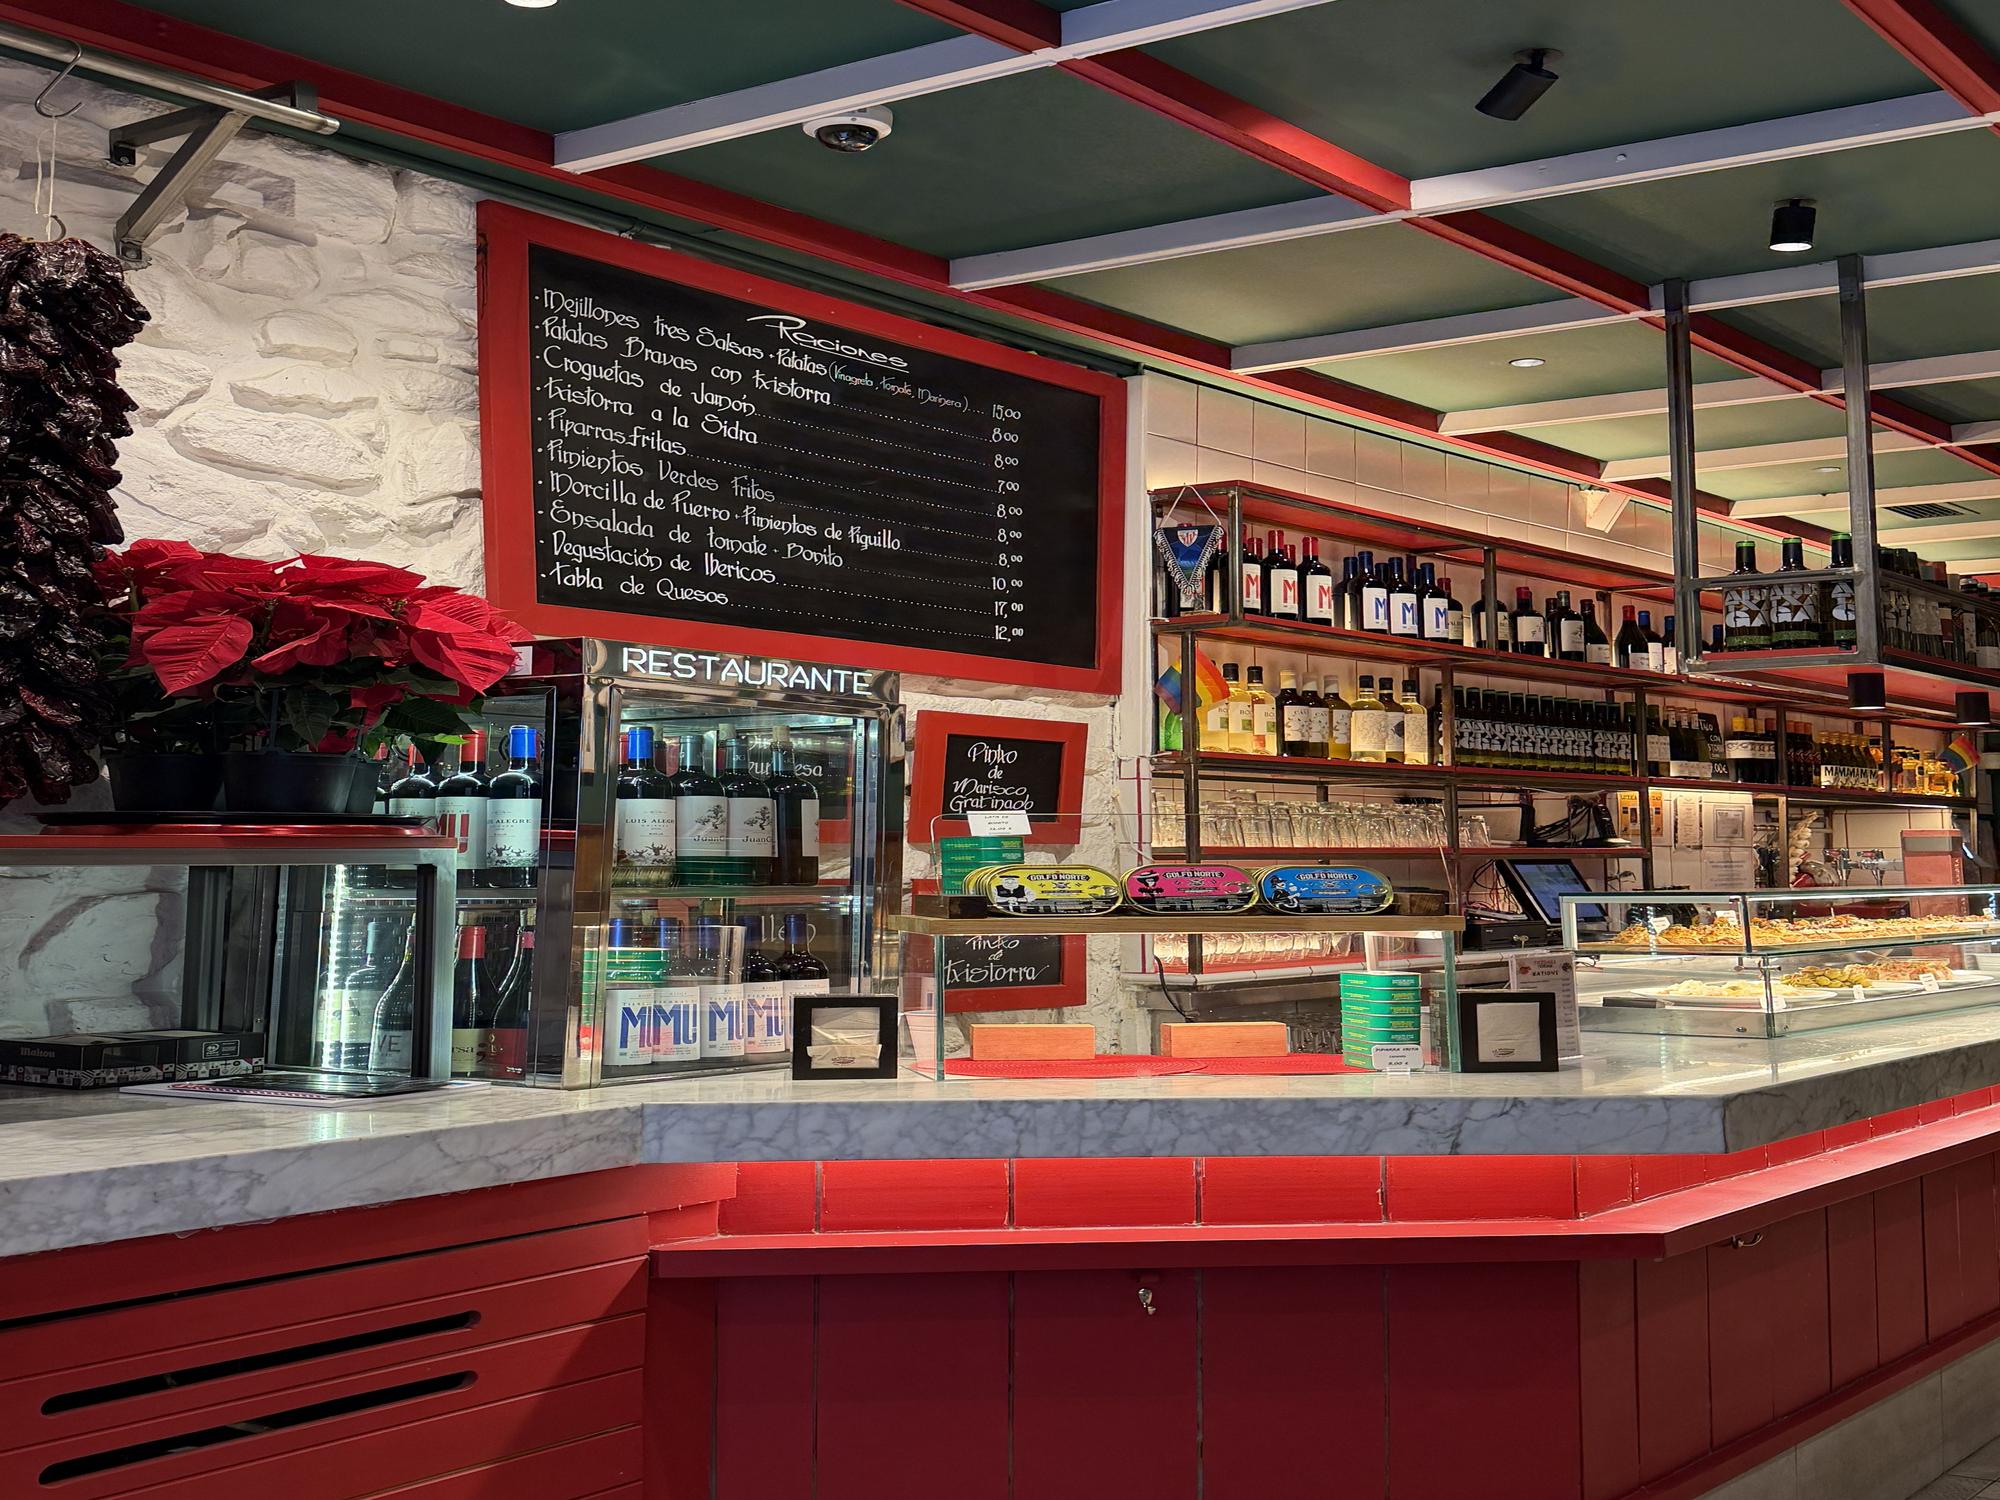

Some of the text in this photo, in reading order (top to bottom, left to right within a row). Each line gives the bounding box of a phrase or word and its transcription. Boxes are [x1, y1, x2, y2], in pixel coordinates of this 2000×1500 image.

[542, 315, 609, 350] Patatas
[619, 336, 698, 372] Bravas
[711, 365, 742, 385] con
[543, 288, 640, 329] Mejillones
[653, 315, 690, 342] tres
[696, 327, 764, 360] Salsas
[776, 348, 828, 376] Patatas
[747, 315, 908, 367] Raciones
[543, 345, 645, 388] Croquetas
[660, 379, 682, 397] de
[690, 382, 756, 417] Jamón
[547, 407, 626, 444] Piparras
[651, 408, 663, 421] a
[672, 406, 689, 428] la
[701, 414, 758, 444] Sidra
[547, 438, 644, 476] Pimientos
[659, 460, 719, 491] Verdes
[731, 475, 775, 502] Fritos
[550, 470, 638, 505] Morcilla
[643, 490, 666, 510] de
[671, 490, 730, 520] Puerro
[741, 505, 817, 539] Pimientos
[824, 522, 843, 540] de
[550, 500, 654, 538] Ensalada
[668, 525, 692, 544] de
[781, 543, 843, 567] Bonito
[552, 530, 662, 572] Degustación
[670, 553, 692, 572] de
[550, 562, 604, 590] Tabla
[620, 575, 645, 595] de
[656, 578, 729, 605] Quesos
[622, 647, 873, 696] RESTAURANTE
[967, 742, 1018, 765] Pintxo
[988, 765, 1003, 779] de
[950, 794, 1034, 814] Gratinado
[953, 778, 1028, 796] Marisco
[1059, 873, 1087, 881] NORTE
[988, 950, 1003, 961] de
